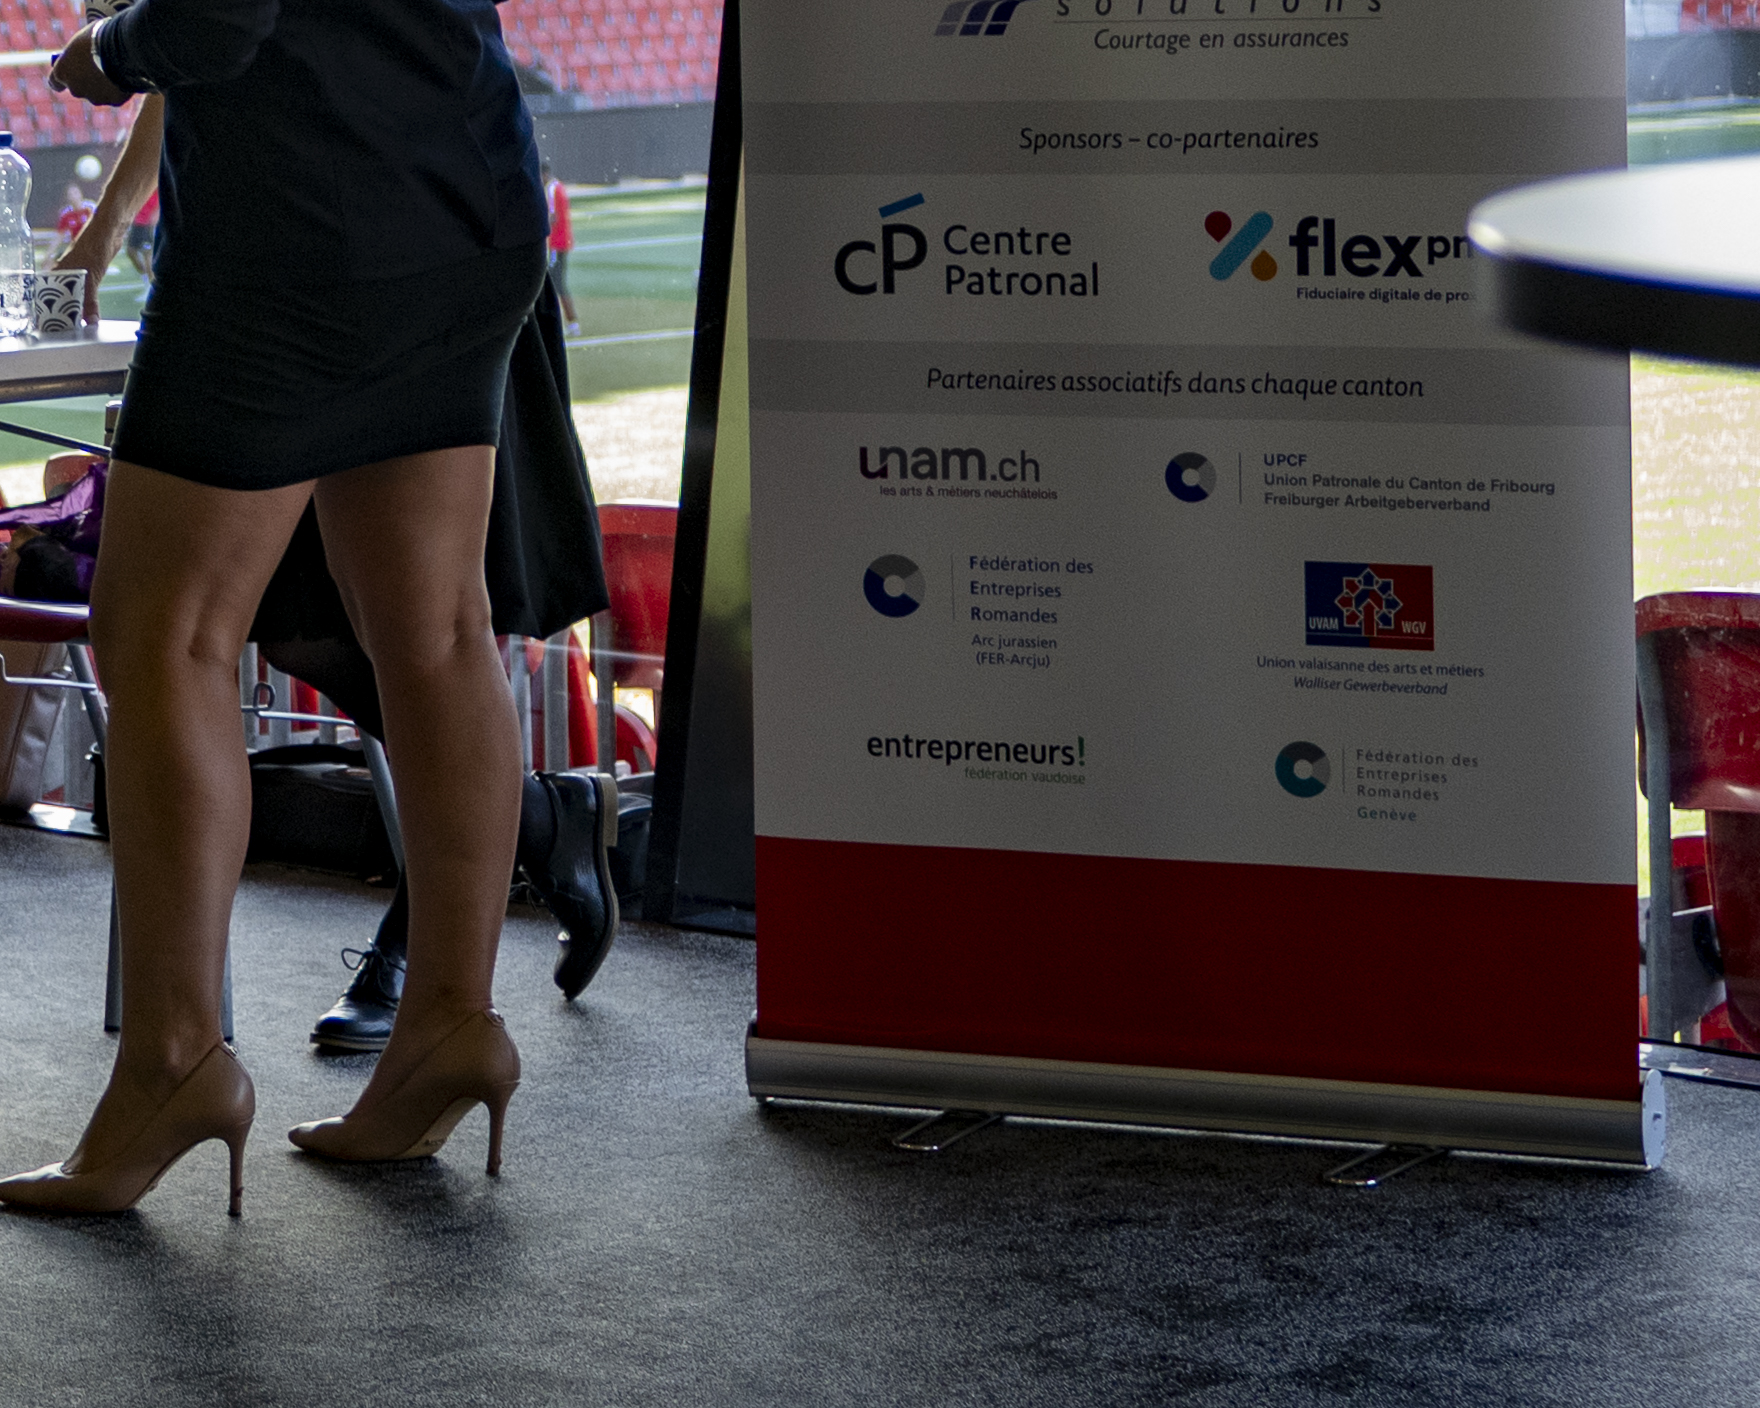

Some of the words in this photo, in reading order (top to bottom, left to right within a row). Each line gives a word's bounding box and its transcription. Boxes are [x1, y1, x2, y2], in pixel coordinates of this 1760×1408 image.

[1094, 28, 1190, 55] Courtage
[1199, 32, 1224, 48] en
[1234, 28, 1348, 49] assurances
[1019, 128, 1123, 153] Sponsors
[1147, 128, 1318, 153] co-partenaires
[944, 224, 1071, 255] Centre
[946, 262, 1098, 296] Patronal
[1297, 288, 1365, 300] Fiduciaire
[1369, 288, 1420, 303] digitale
[1424, 289, 1442, 300] de
[1446, 291, 1469, 304] pro
[927, 368, 1056, 393] Partenaires
[1061, 370, 1182, 396] associatifs
[1188, 372, 1246, 394] dans
[1250, 372, 1336, 400] chaque
[1342, 376, 1423, 397] canton
[859, 446, 1040, 482] unam.ch
[1263, 454, 1307, 466] UPCF
[900, 486, 922, 496] arts
[938, 486, 981, 498] métiers
[985, 488, 1058, 500] neuchâtelois
[1264, 474, 1307, 486] Union
[1312, 476, 1381, 488] Patronale
[1385, 477, 1404, 489] du
[1408, 478, 1462, 491] Canton
[1467, 479, 1486, 492] de
[1490, 480, 1555, 495] Fribourg
[1264, 493, 1340, 508] Freiburger
[1344, 495, 1490, 512] Arbeitgeberverband
[969, 556, 1060, 573] Fédération
[1066, 558, 1094, 574] des
[970, 581, 1061, 599] Entreprises
[970, 607, 1058, 623] Romandes
[1308, 617, 1338, 630] UVAM
[1402, 622, 1426, 634] WGV
[972, 634, 994, 647] Arc
[998, 634, 1057, 649] jurassien
[976, 652, 1051, 668] (FER-Arcju)
[1257, 656, 1295, 669] Union
[1299, 658, 1365, 671] valaisanne
[1368, 660, 1390, 673] des
[1393, 662, 1416, 674] arts
[1436, 664, 1484, 677] métiers
[1294, 677, 1340, 690] Walliser
[1344, 678, 1447, 695] Gewerbeverband
[867, 734, 1085, 766] entrepreneurs!
[1356, 749, 1444, 765] Fédération
[1452, 753, 1478, 767] des
[1356, 767, 1448, 783] Entreprises
[1357, 784, 1440, 801] Romandes
[1357, 807, 1417, 821] Genève
